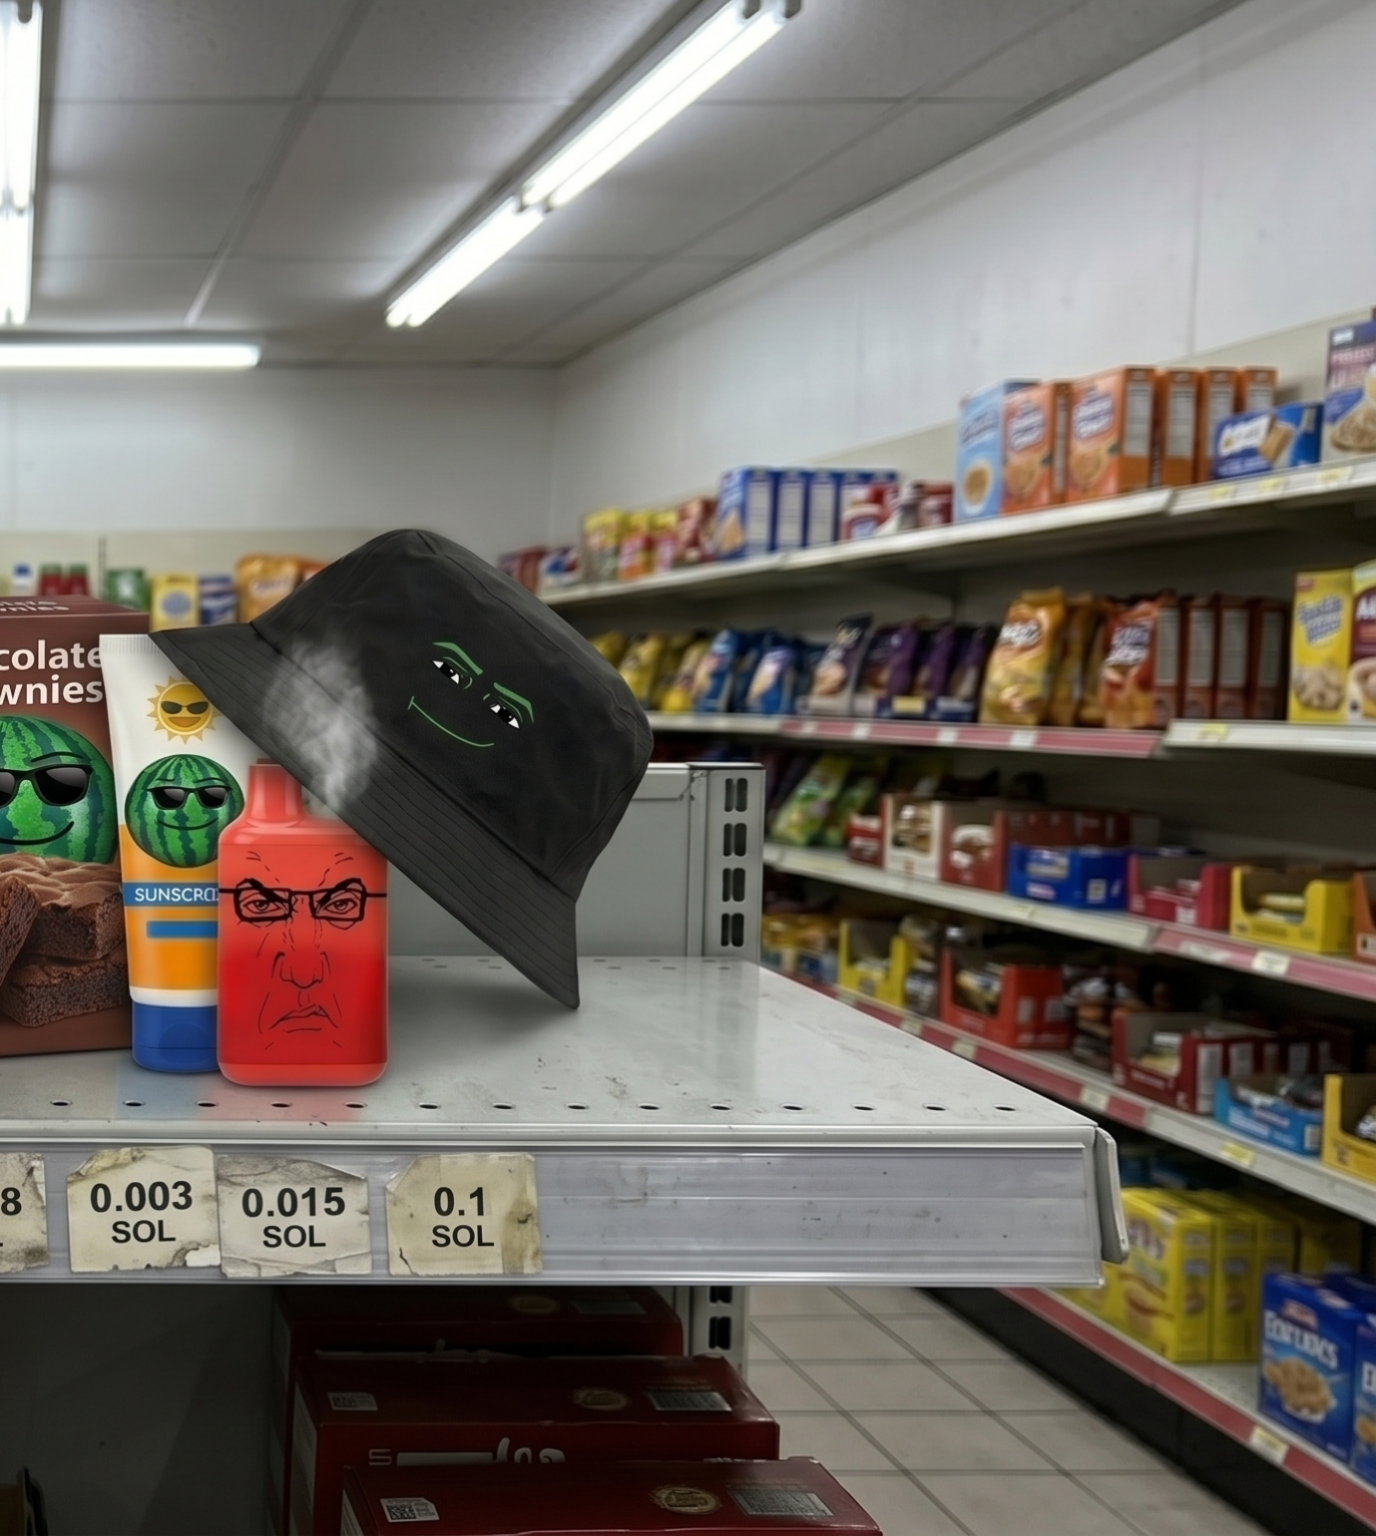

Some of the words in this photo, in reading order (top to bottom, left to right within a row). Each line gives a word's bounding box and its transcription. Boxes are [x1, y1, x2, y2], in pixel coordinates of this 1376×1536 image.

[90, 1181, 193, 1212] 0.003
[242, 1187, 346, 1217] 0.015
[434, 1187, 486, 1216] 0.1
[111, 1220, 176, 1244] SOL
[263, 1225, 326, 1248] SOL
[432, 1225, 495, 1248] SOL
